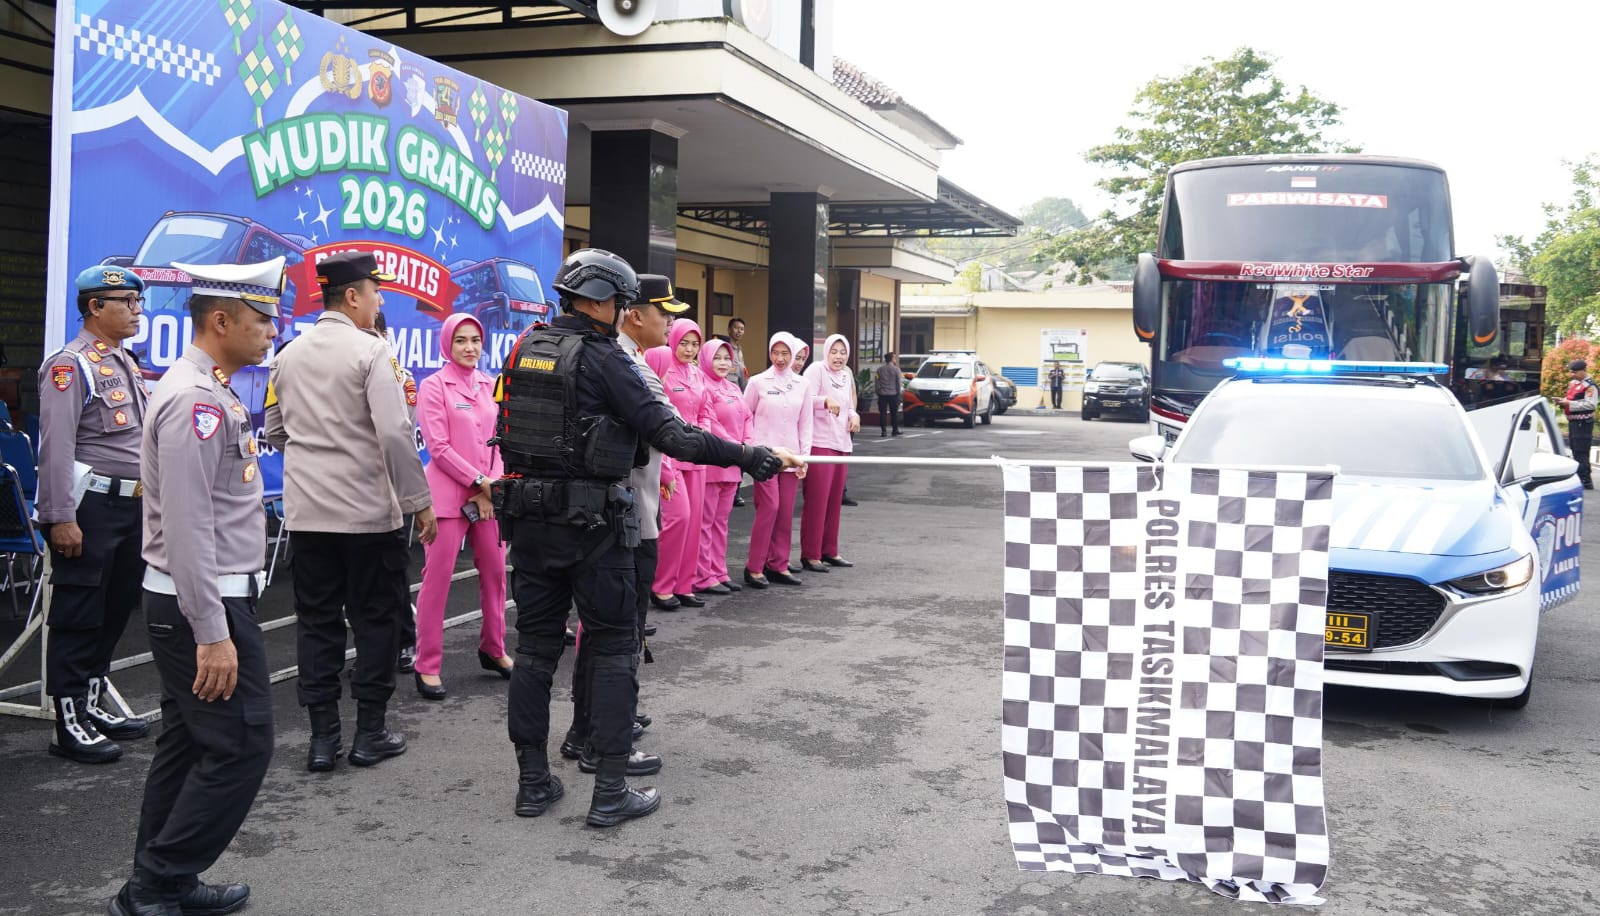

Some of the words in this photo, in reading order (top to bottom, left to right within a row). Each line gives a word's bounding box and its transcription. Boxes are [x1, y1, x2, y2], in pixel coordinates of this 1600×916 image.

[249, 120, 387, 190] MUDIK
[398, 132, 498, 226] GRATIS
[342, 179, 426, 235] 2026
[1230, 193, 1384, 207] PARIWISATA
[373, 250, 440, 297] GRATIS
[1240, 264, 1331, 277] RedWhite
[1332, 265, 1374, 277] Star
[100, 377, 122, 388] YUDI
[519, 357, 556, 371] BRIMOB
[1144, 499, 1180, 610] POLRES
[1131, 621, 1176, 834] TASIKMALAYA
